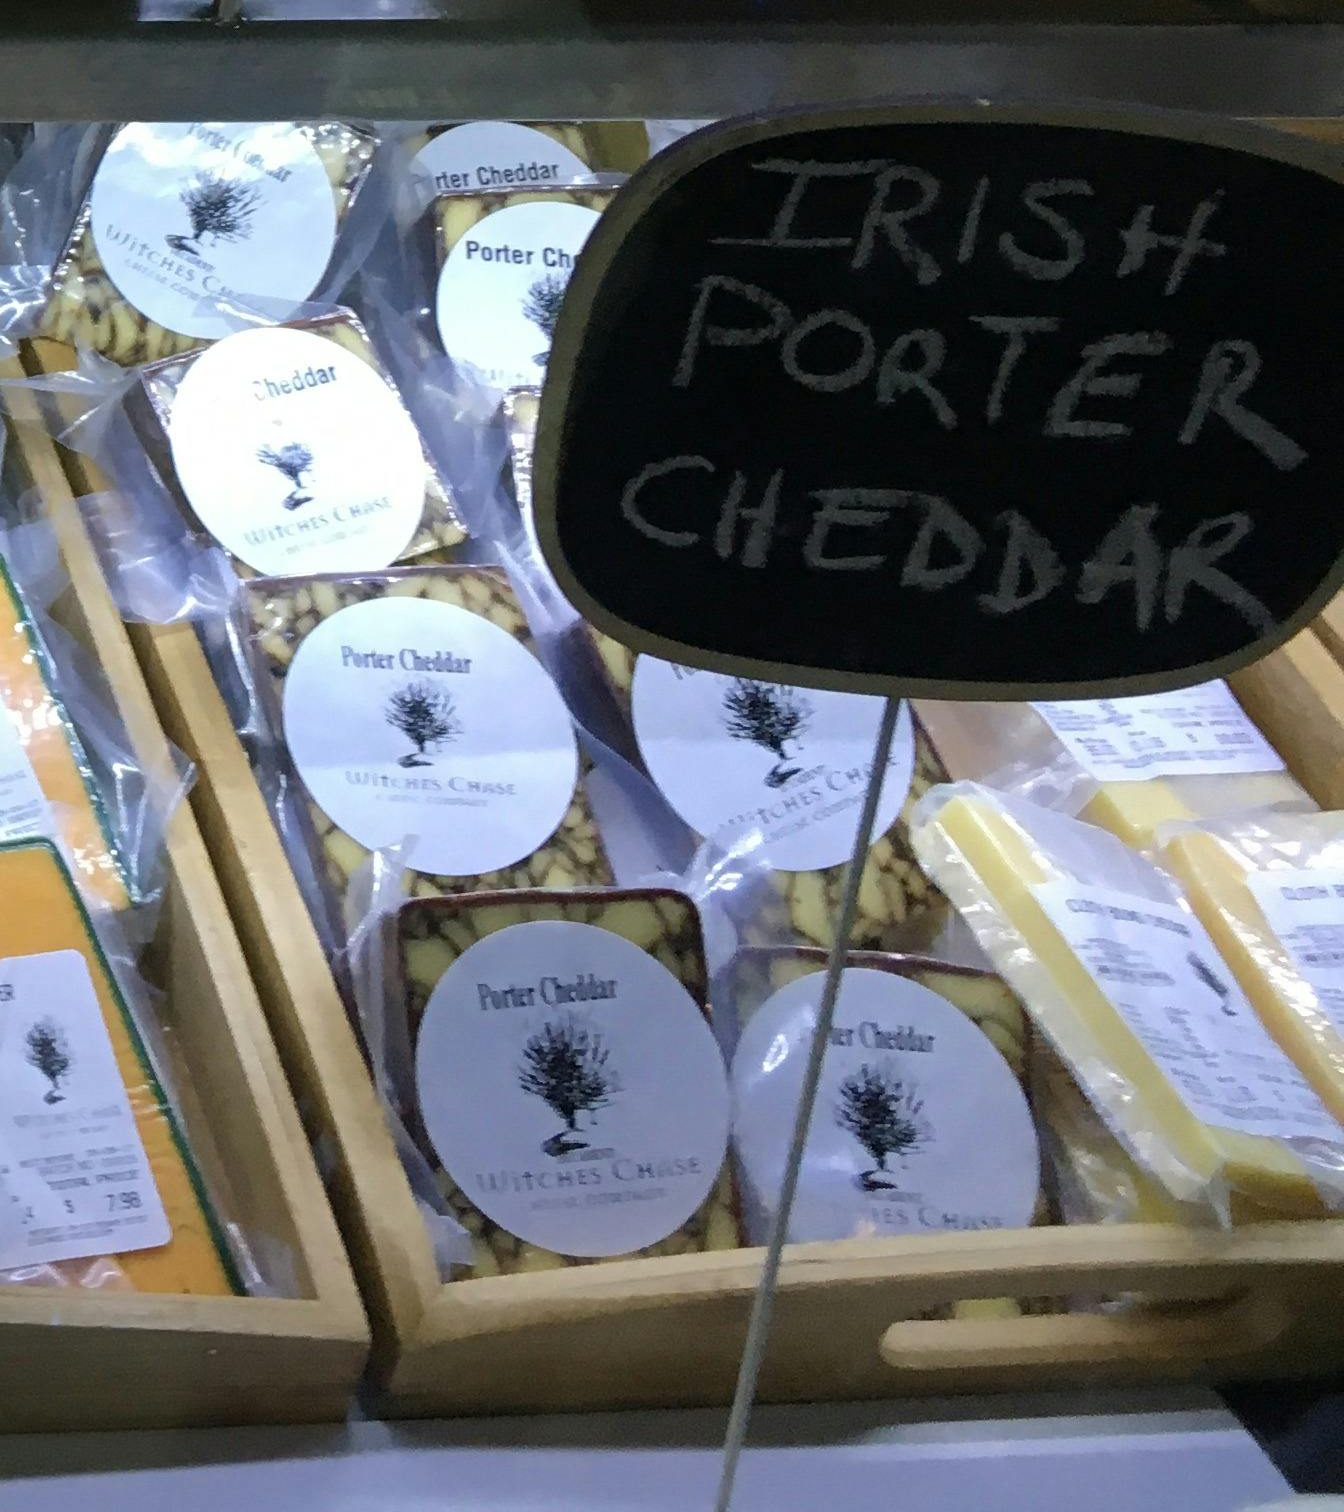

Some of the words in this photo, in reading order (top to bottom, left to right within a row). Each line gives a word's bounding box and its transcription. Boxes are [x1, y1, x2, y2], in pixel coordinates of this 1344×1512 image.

[435, 171, 469, 189] rter
[476, 162, 560, 186] Cheddar
[710, 158, 1227, 295] IRISH
[466, 240, 534, 265] Porter
[252, 365, 338, 401] Cheddar
[671, 275, 1308, 472] PORTER
[621, 455, 1279, 631] CHEDDAR
[341, 646, 393, 670] Porter
[400, 648, 472, 674] Cheddar
[477, 983, 535, 1011] Porter
